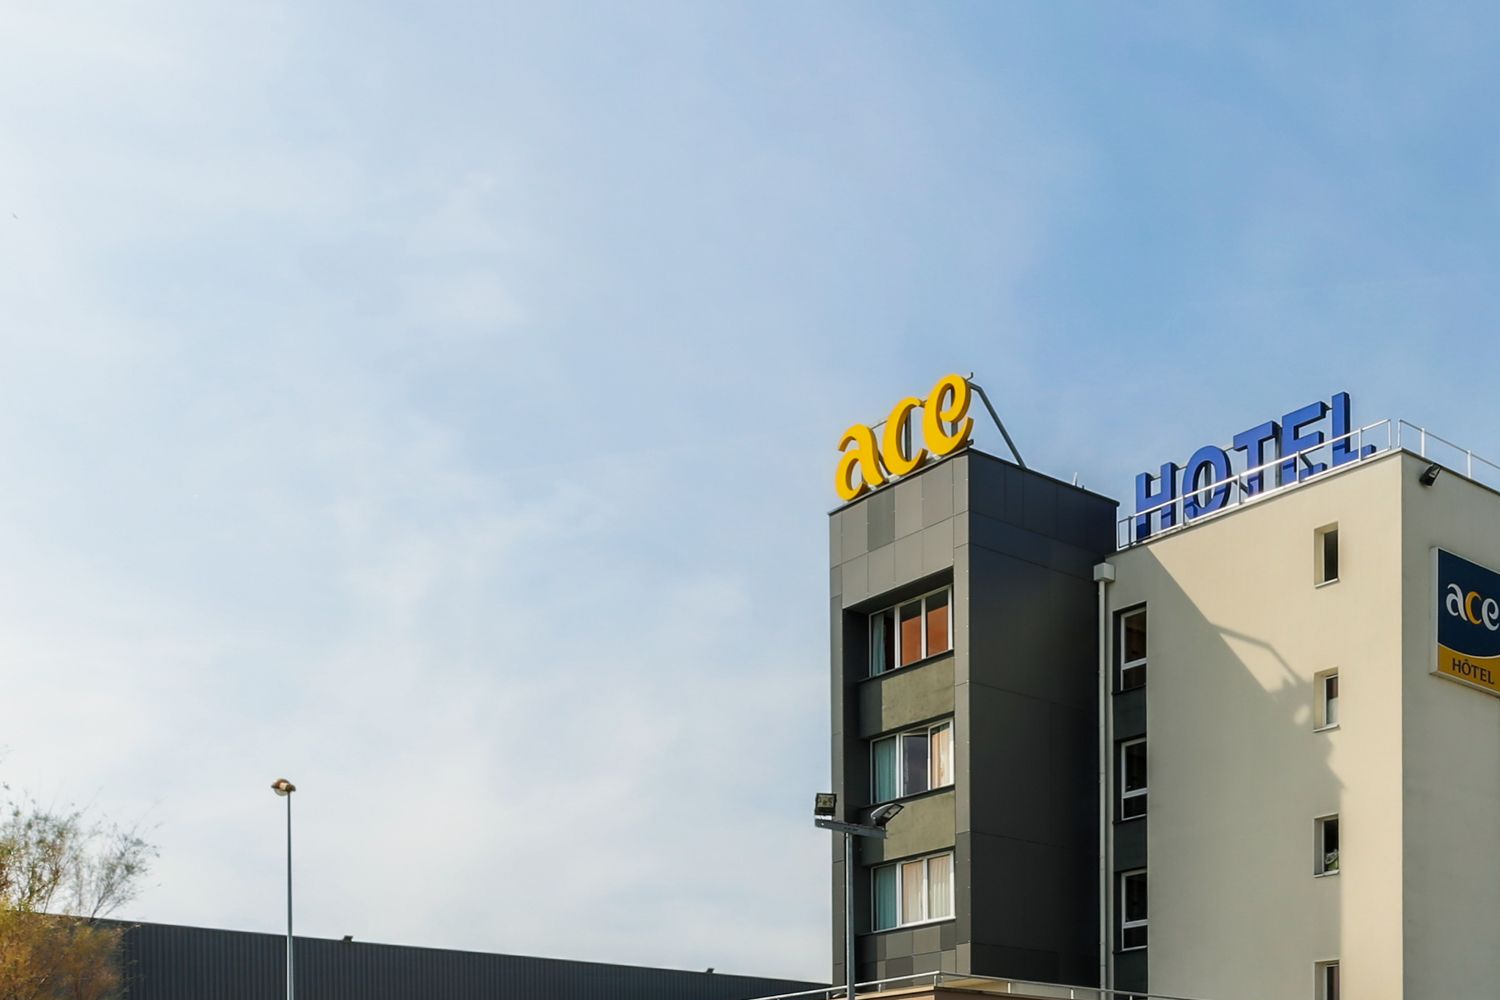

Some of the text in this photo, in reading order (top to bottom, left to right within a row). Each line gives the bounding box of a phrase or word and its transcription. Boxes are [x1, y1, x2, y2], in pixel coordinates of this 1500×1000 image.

[835, 373, 974, 501] ace
[1135, 391, 1376, 543] HOTEL
[1446, 583, 1500, 631] ace
[1452, 657, 1495, 685] HÔTEL
